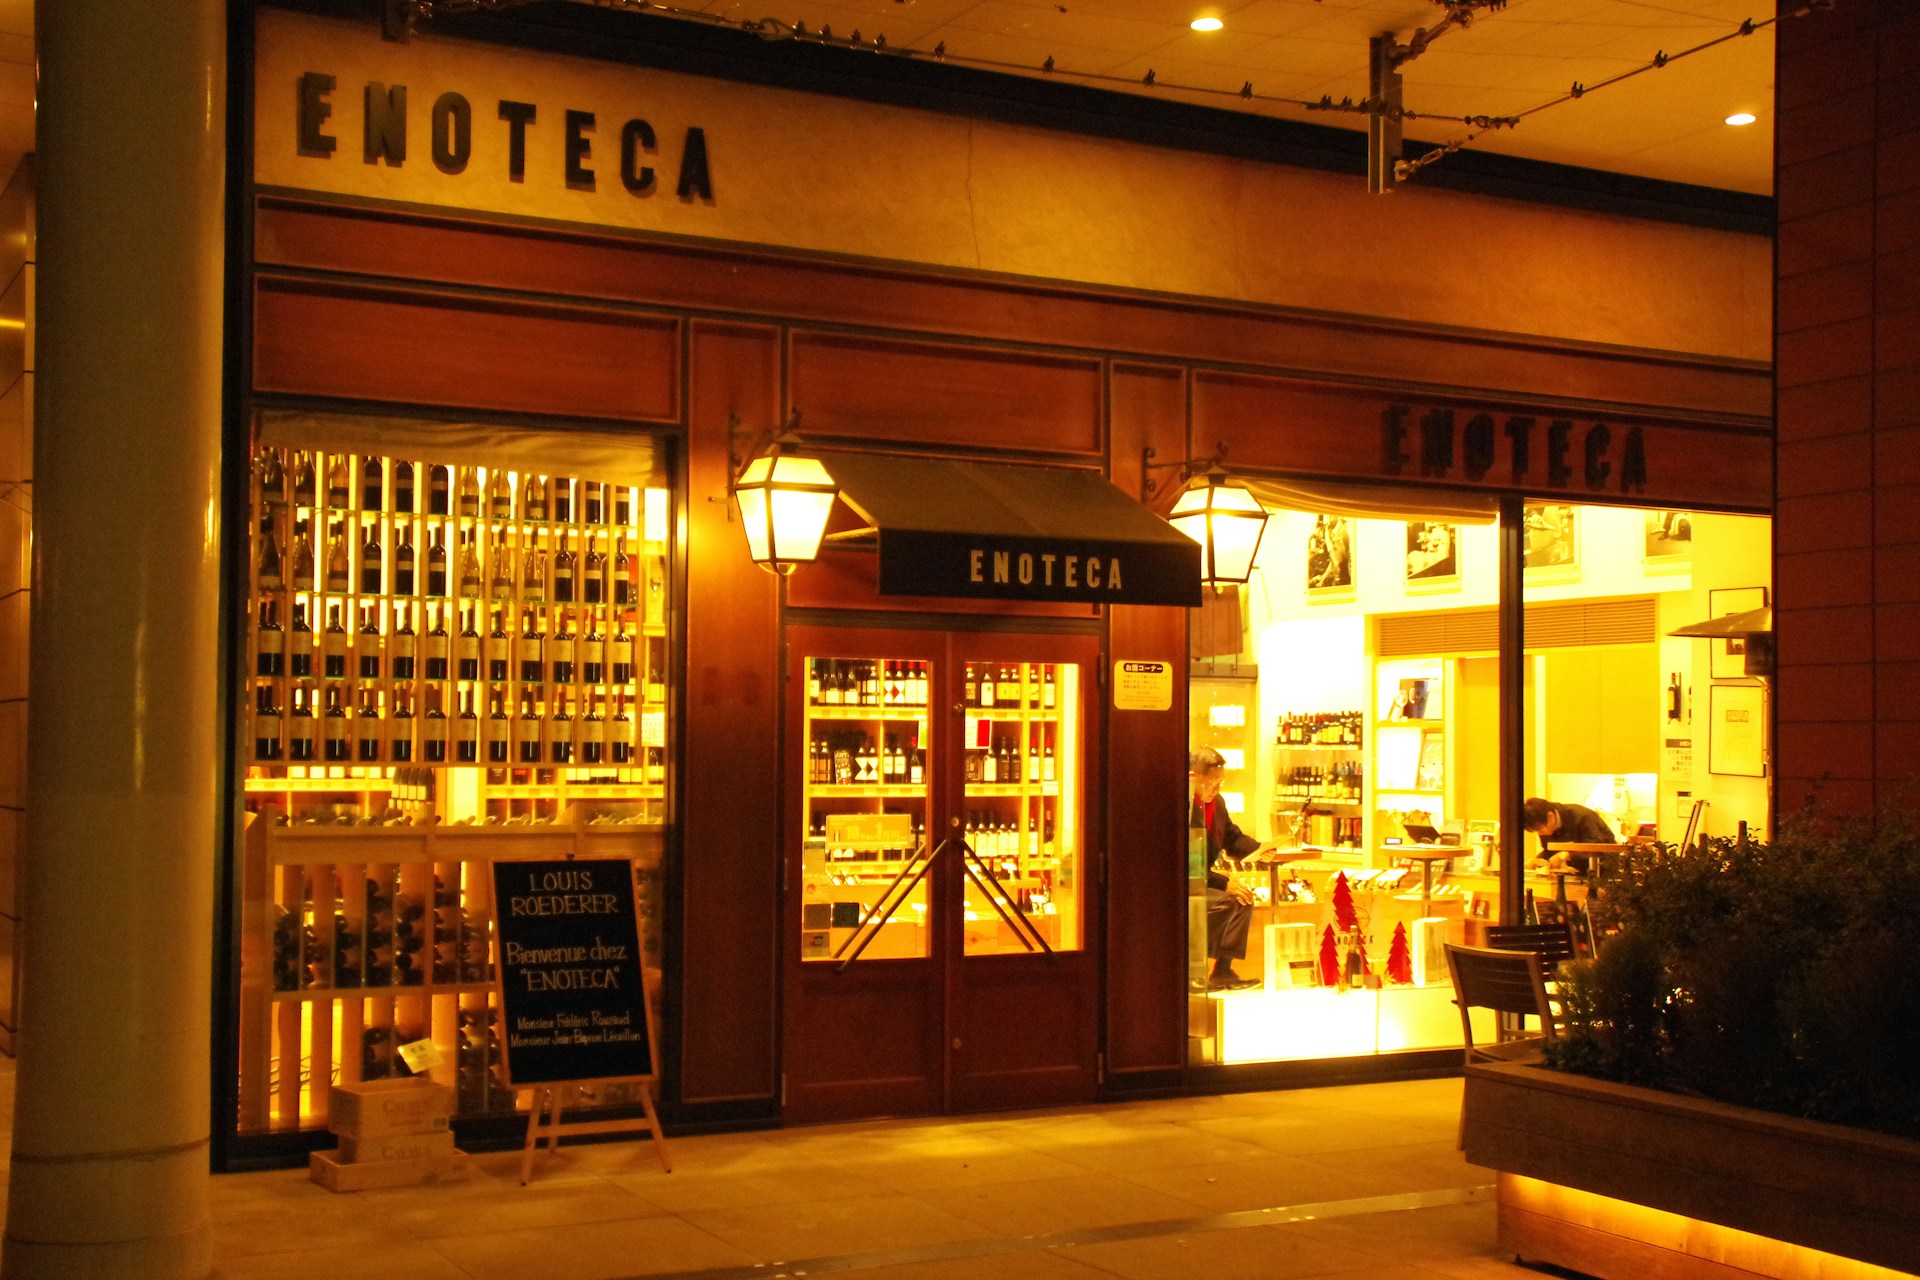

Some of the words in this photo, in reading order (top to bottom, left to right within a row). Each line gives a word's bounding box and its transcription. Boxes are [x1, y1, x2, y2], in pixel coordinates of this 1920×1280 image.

[296, 71, 717, 206] ENOTECA
[1381, 402, 1648, 494] ENOTECA
[970, 549, 1123, 590] ENOTECA
[530, 871, 593, 892] LOUIS
[511, 894, 619, 917] ROEDERER
[505, 941, 587, 966] Bienvenue
[590, 936, 628, 961] chez
[520, 966, 620, 991] "ENOTECA"
[517, 1016, 554, 1030] Monsieur
[510, 1033, 550, 1048] Monsieur
